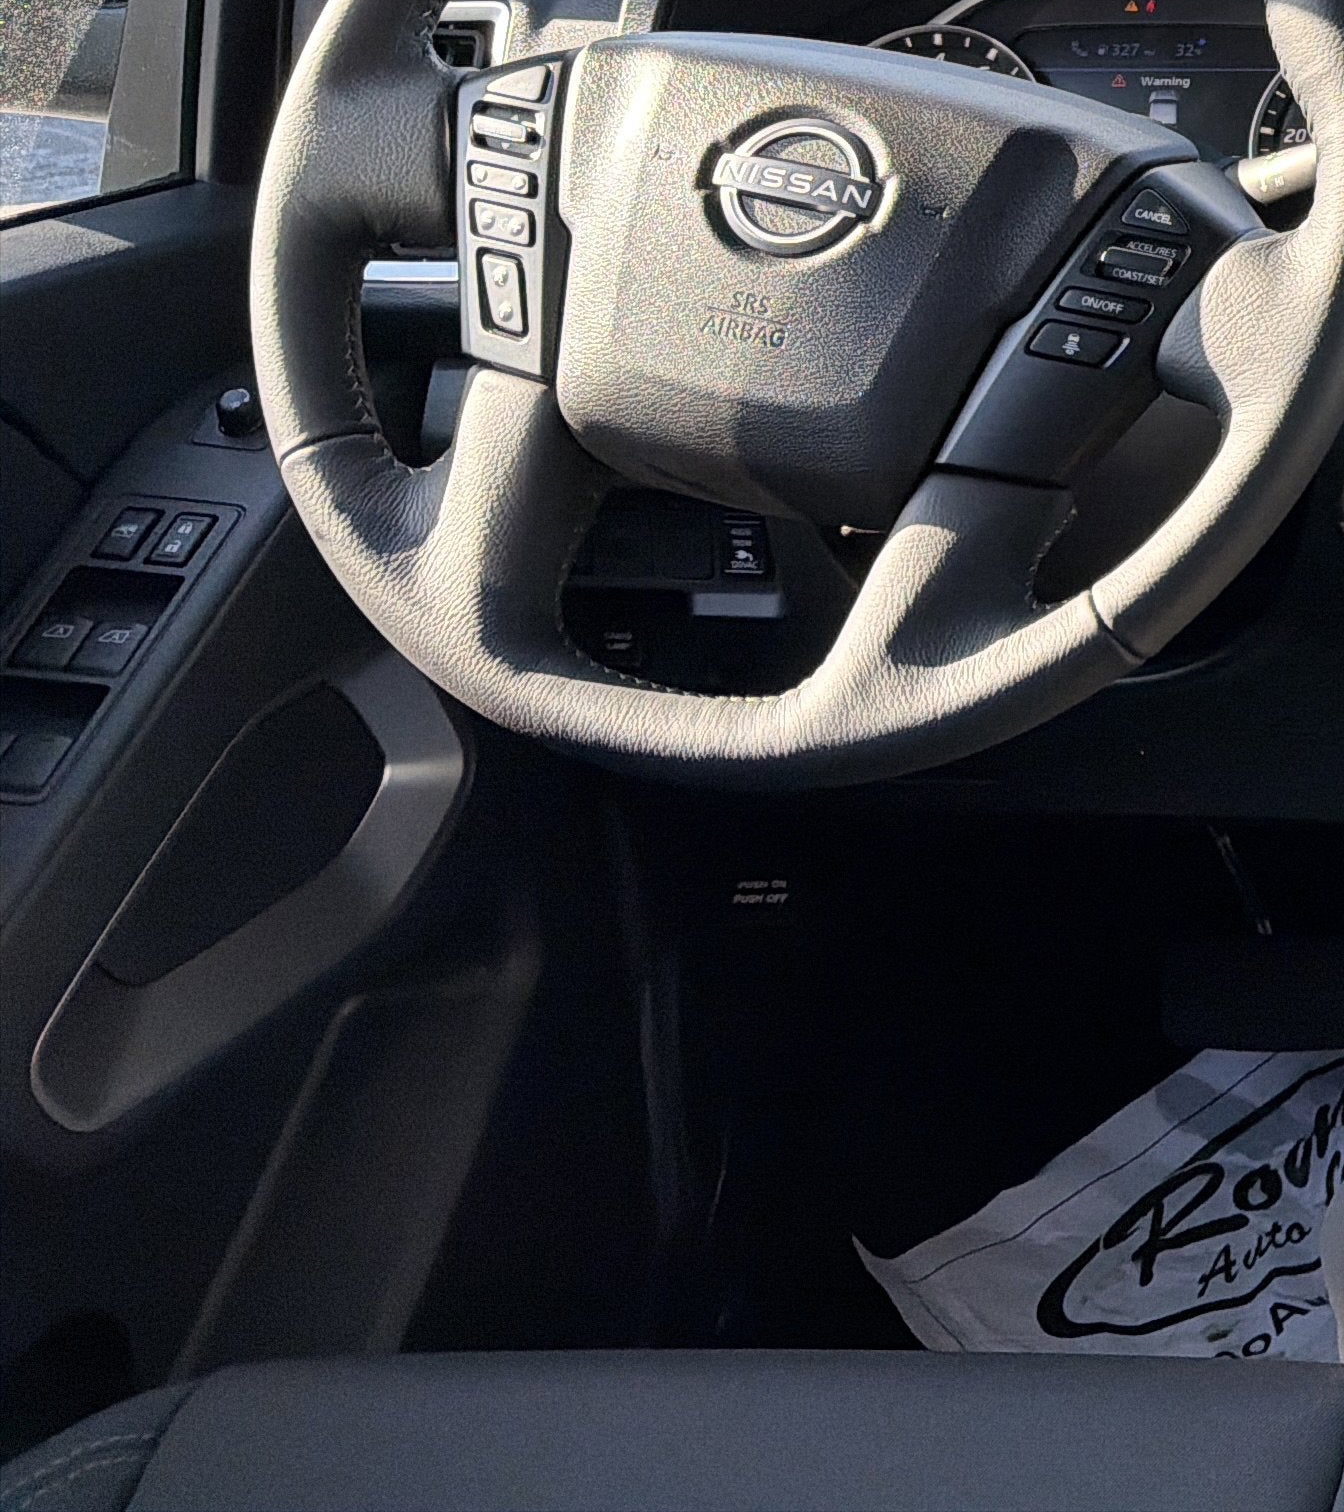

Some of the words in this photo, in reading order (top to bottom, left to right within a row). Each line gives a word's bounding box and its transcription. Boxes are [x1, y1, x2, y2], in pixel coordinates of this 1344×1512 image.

[1112, 43, 1140, 56] 327
[1141, 76, 1191, 88] Warning
[1283, 128, 1307, 143] 20
[721, 157, 873, 209] NISSAN
[1134, 208, 1172, 226] CANCEL
[1126, 241, 1178, 258] ACCEL/RES
[1112, 268, 1165, 286] COAST/SET
[731, 290, 770, 316] SRS
[1081, 296, 1124, 314] ON/OFF
[700, 314, 786, 349] AIRBAG
